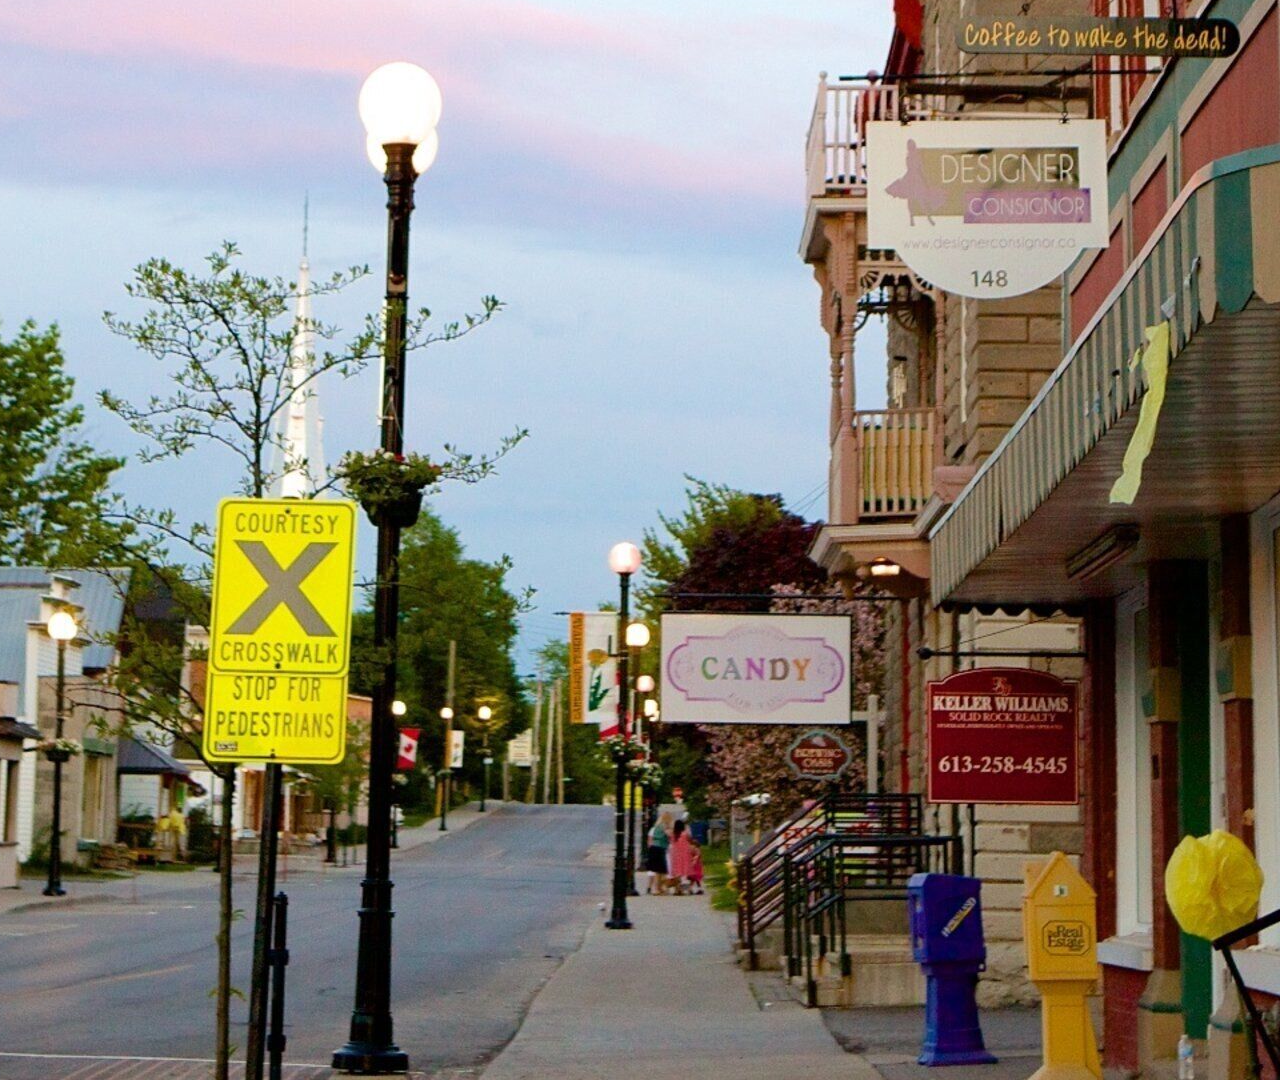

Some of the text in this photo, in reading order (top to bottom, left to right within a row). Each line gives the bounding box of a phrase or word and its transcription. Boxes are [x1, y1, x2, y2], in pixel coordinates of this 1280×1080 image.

[965, 22, 1227, 51] Coffee to wake the dead!
[941, 153, 1074, 184] DESIGNER
[969, 197, 1085, 216] CONSIGNOR
[903, 235, 1076, 251] www.designerconsignor.ca
[971, 270, 1008, 287] 148
[235, 512, 339, 535] COURTESY
[220, 641, 338, 663] CROSSWALK
[701, 656, 811, 681] CANDY
[232, 675, 321, 702] STOP FOR
[933, 696, 1069, 712] KELLER WILLIAMS
[215, 710, 335, 738] PEDESTRIANS
[949, 712, 1056, 722] SOLID ROCK REALTY
[938, 755, 1067, 773] 613-258-4545
[1057, 925, 1083, 937] Real
[1048, 935, 1085, 948] Estate
